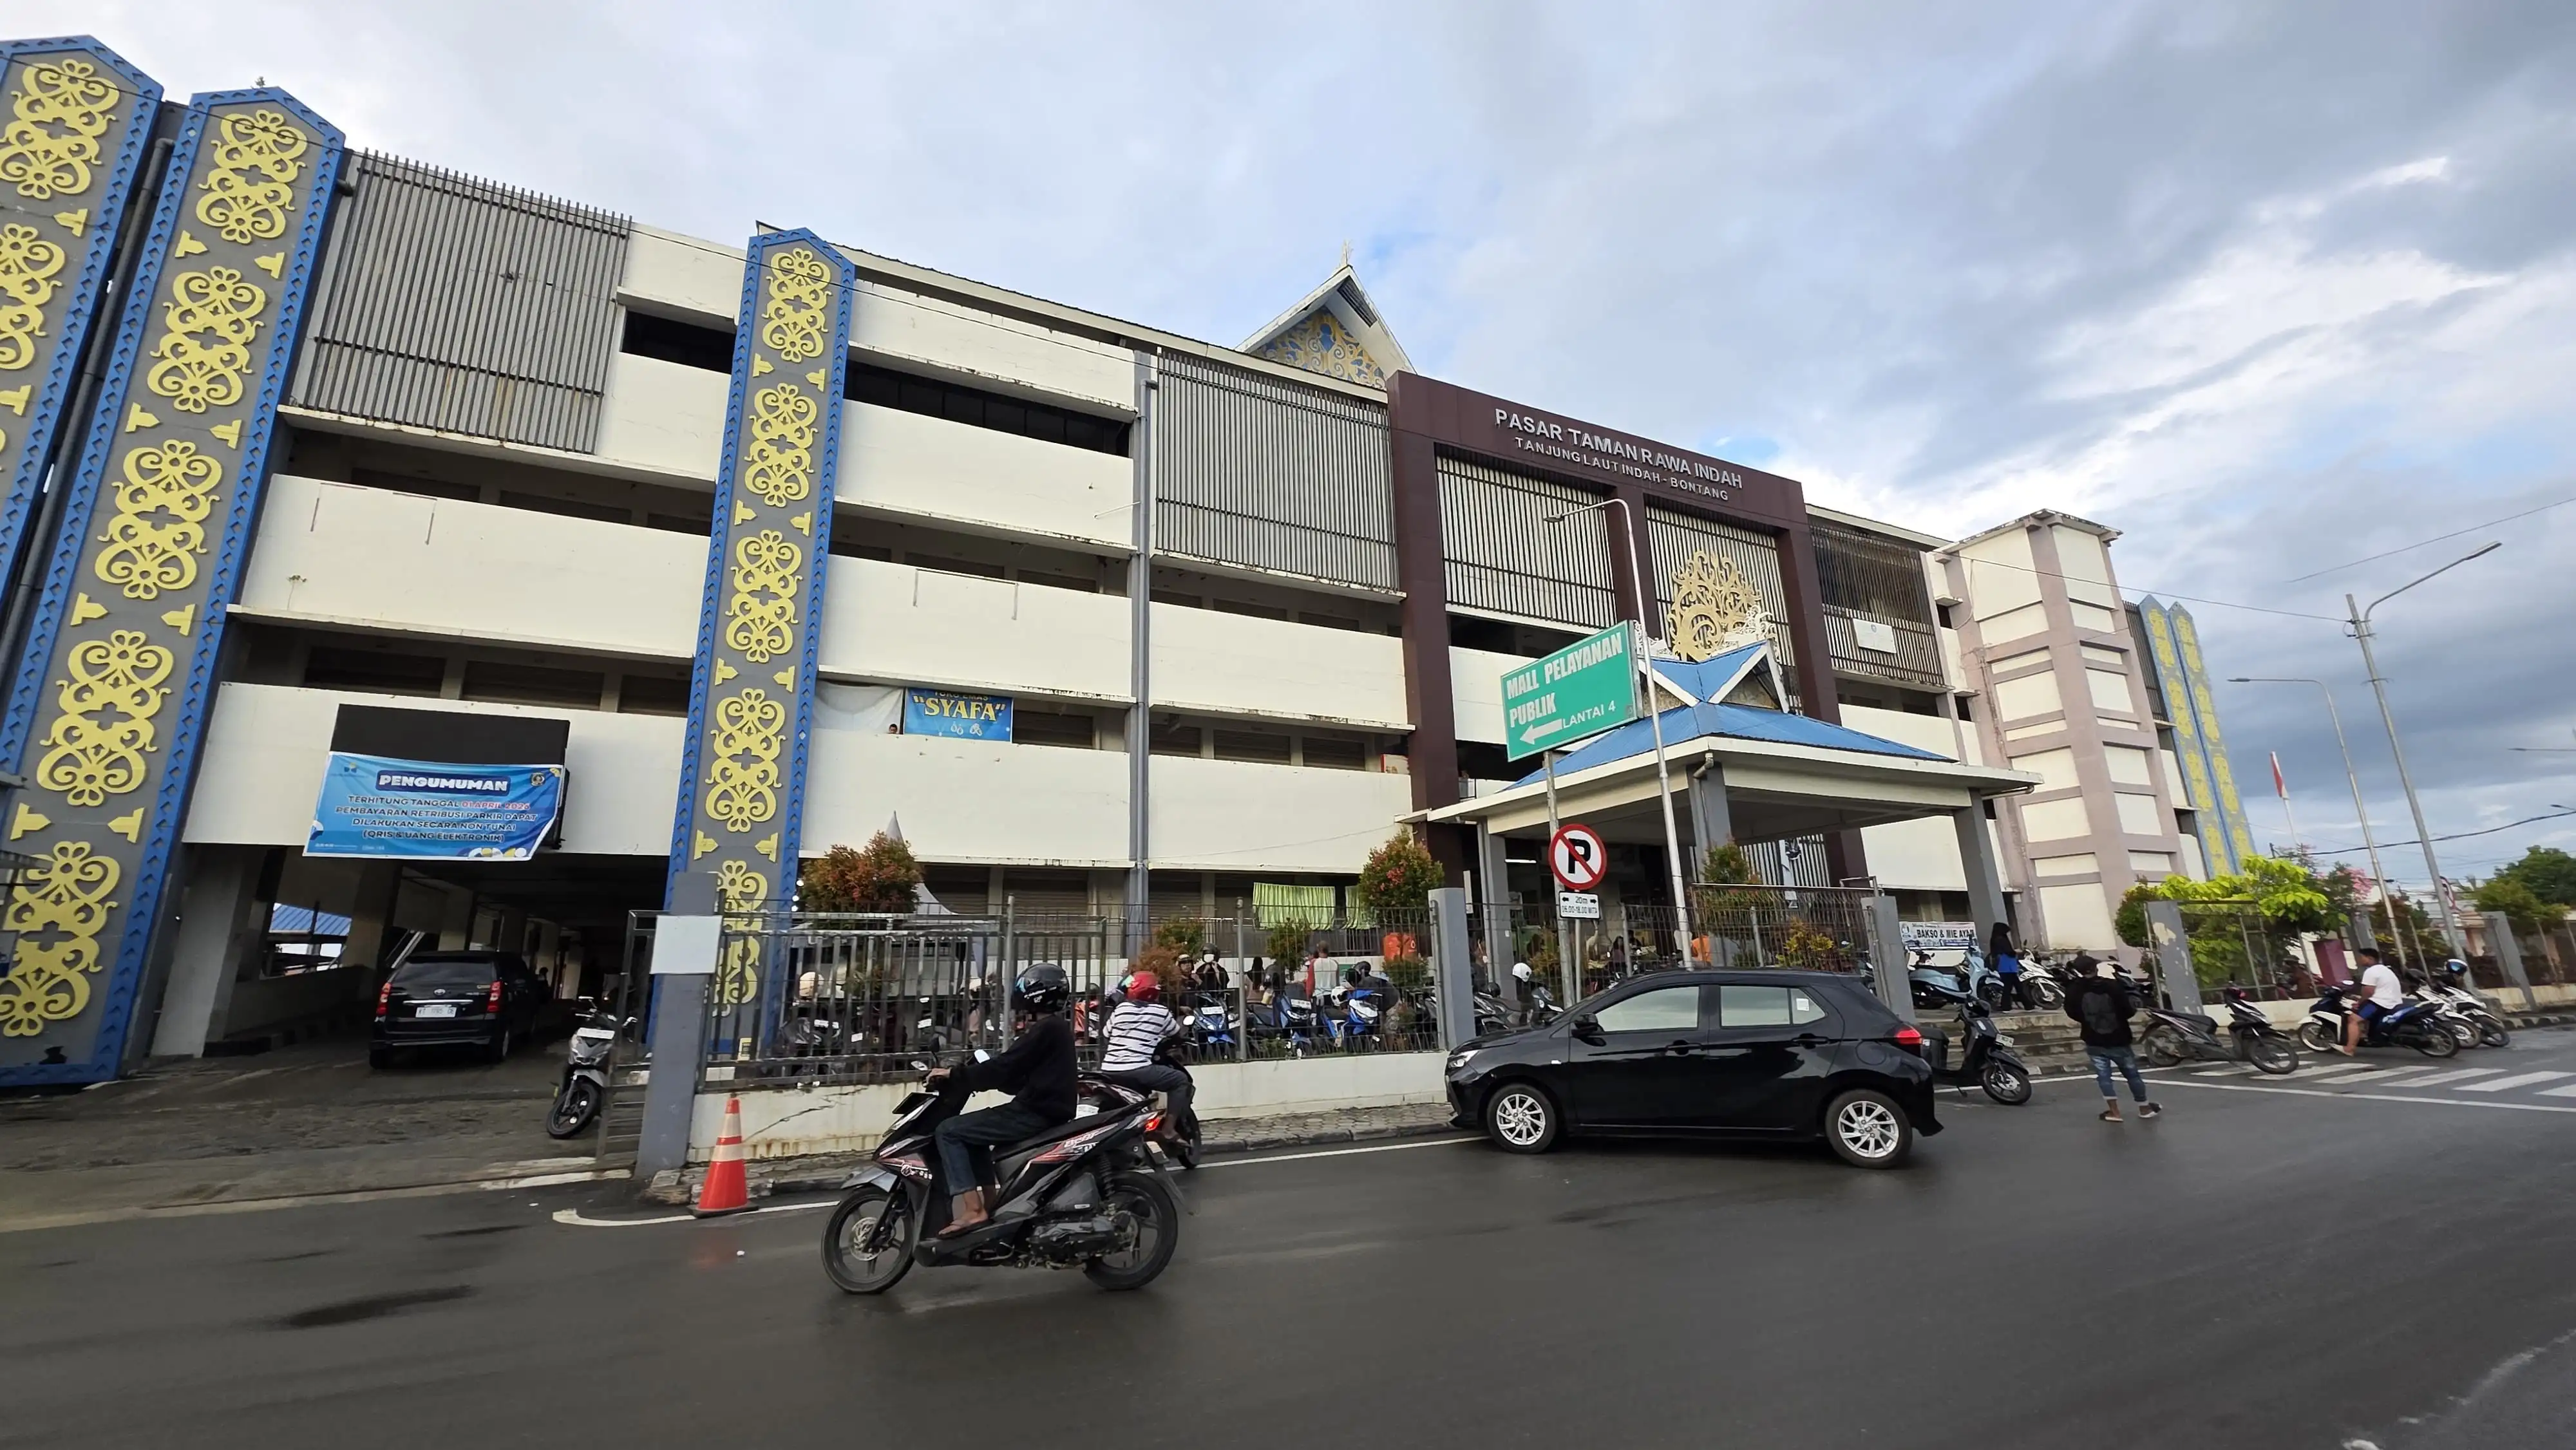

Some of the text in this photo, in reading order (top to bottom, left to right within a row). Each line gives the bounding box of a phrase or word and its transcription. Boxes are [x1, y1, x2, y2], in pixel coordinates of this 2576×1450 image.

[1495, 408, 1743, 489] PASAR TAMAN RAWA INDAH
[1515, 437, 1580, 462] TANJUNG
[1584, 454, 1618, 472] LAUT
[1622, 463, 1660, 484] INDAH
[1670, 476, 1728, 501] BONTANG
[1507, 632, 1623, 700] MALL PELAYANAN
[1510, 692, 1557, 728] PUBLIK
[1563, 700, 1616, 728] LANTAI 4
[379, 775, 507, 791] PENGUMUMAN
[336, 806, 408, 816] PEMBAYARAN
[411, 810, 464, 818] RETRIBUSI
[348, 795, 408, 805] TERHITUNG
[410, 798, 459, 807] TANGGAL
[473, 801, 502, 809] APRIL
[353, 818, 414, 827] DILAKUKAN
[363, 830, 393, 838] (QRIS
[437, 833, 505, 842] ELEKTRONIK)
[1568, 838, 1591, 874] P
[1917, 929, 1938, 938] BAKSO
[1940, 929, 1945, 938] &
